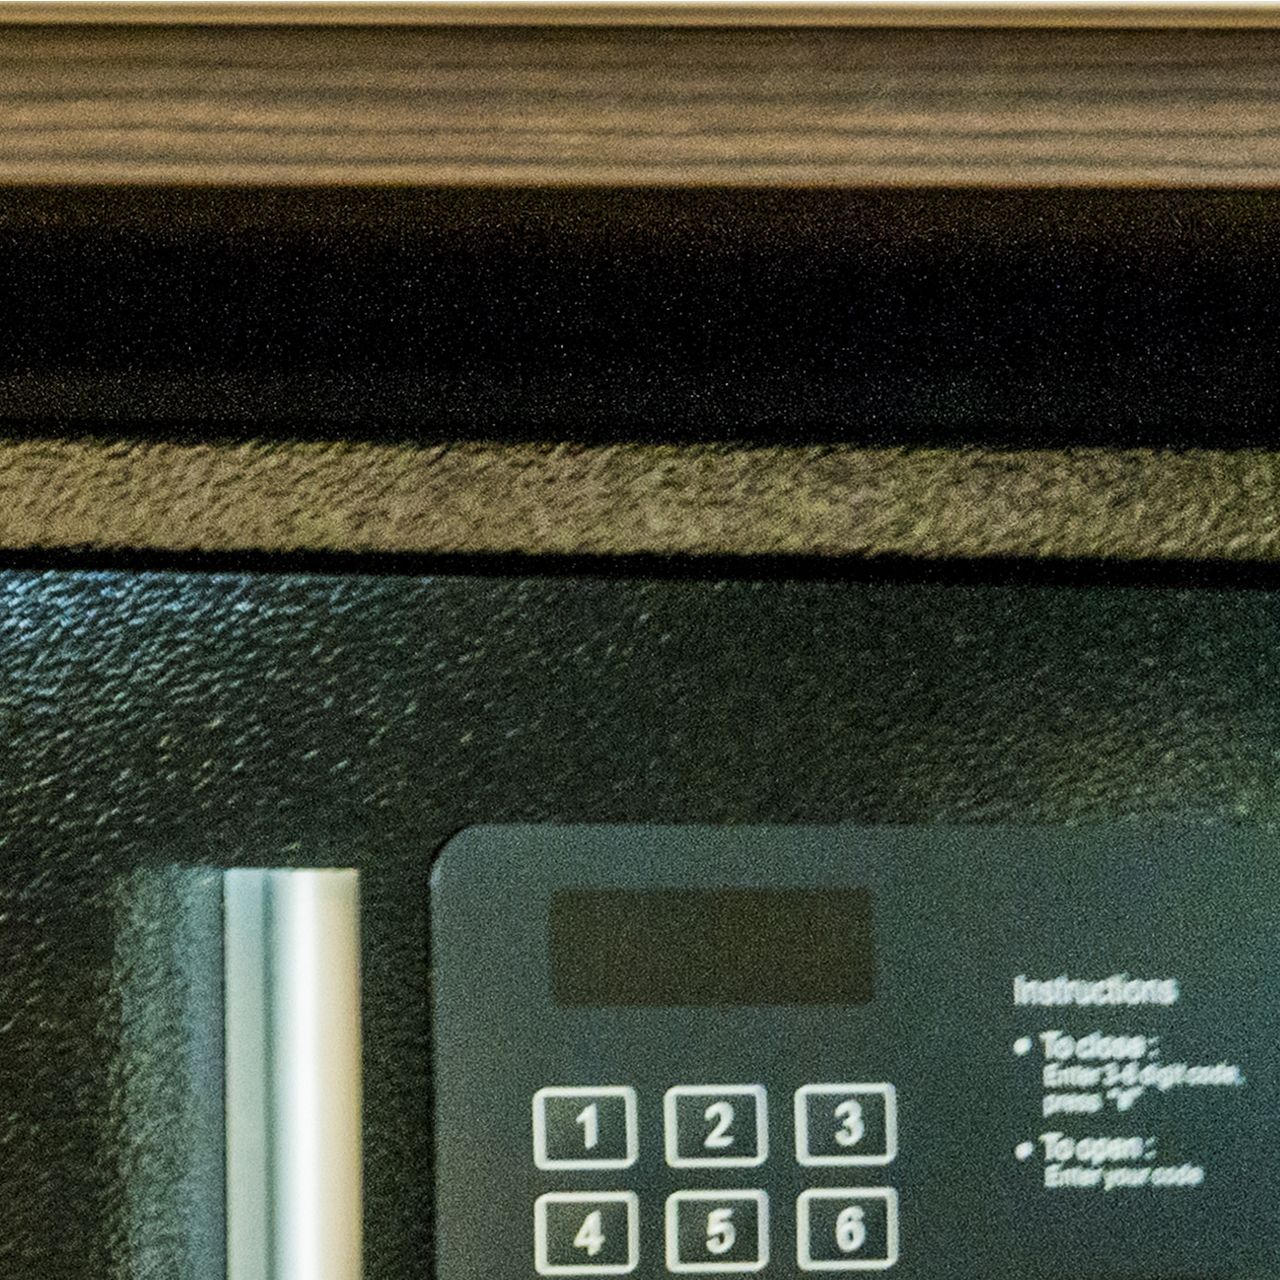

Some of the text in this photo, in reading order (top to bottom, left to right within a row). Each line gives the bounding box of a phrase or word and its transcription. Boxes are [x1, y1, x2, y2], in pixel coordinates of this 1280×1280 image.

[1014, 975, 1178, 1005] Instructions
[1039, 1030, 1075, 1060] To
[1043, 1062, 1102, 1088] Enter
[575, 1100, 865, 1149] 1 2 3
[1039, 1132, 1075, 1160] To
[1044, 1163, 1102, 1188] Enter
[573, 1205, 866, 1256] 4 5 6
